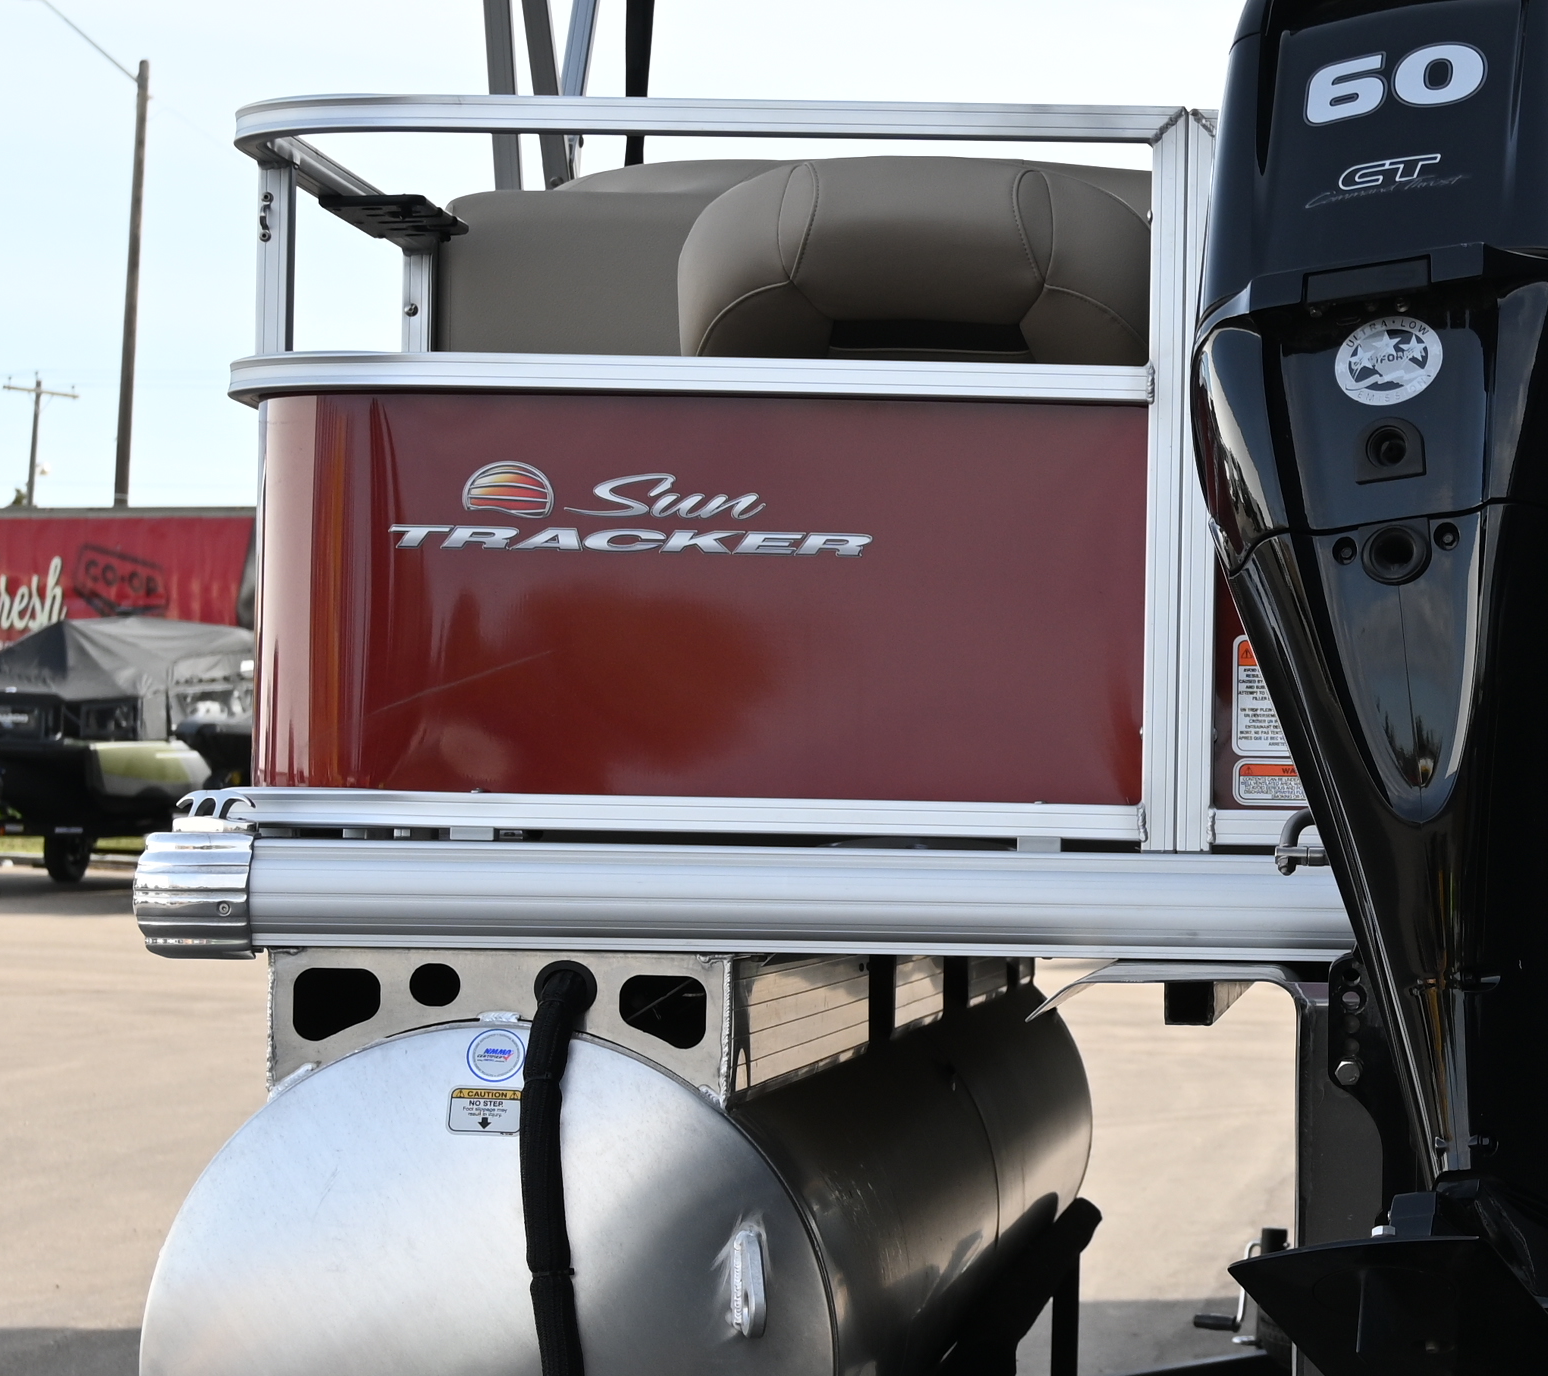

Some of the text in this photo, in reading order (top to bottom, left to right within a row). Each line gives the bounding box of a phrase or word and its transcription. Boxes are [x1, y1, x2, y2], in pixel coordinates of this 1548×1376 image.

[1303, 41, 1489, 127] 60
[1338, 153, 1441, 191] CT
[1305, 174, 1470, 209] Command Thrust
[1346, 319, 1430, 348] ULTRA LOW
[564, 472, 766, 520] Sun
[388, 524, 873, 558] TRACKER
[85, 559, 160, 598] CO-OP
[467, 1090, 507, 1098] CAUTION
